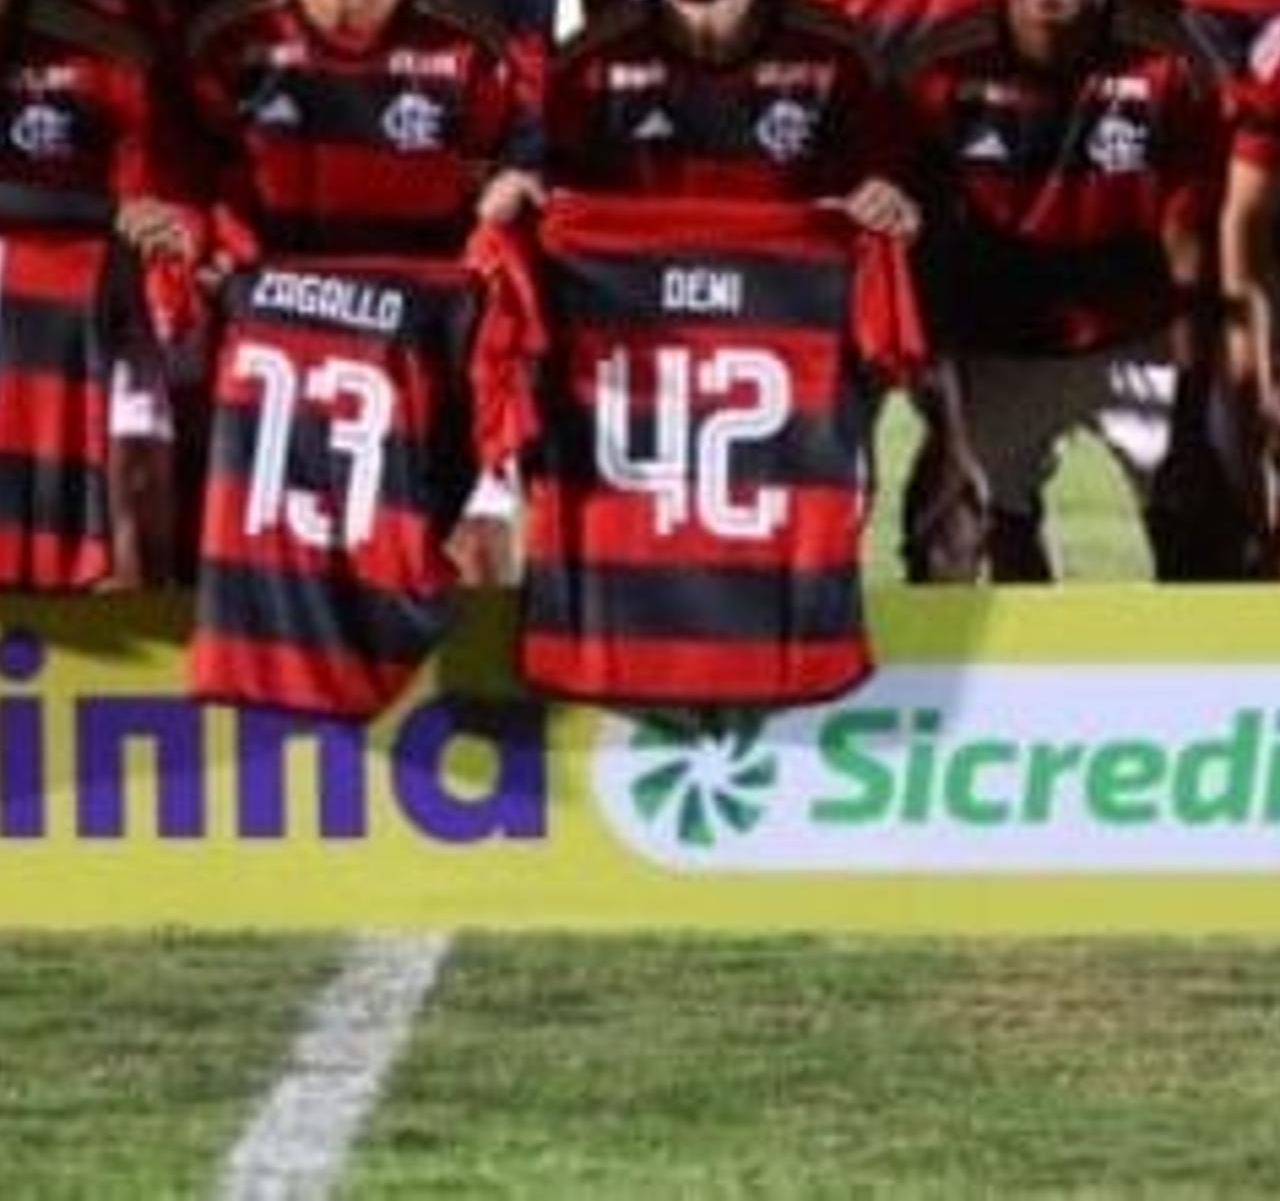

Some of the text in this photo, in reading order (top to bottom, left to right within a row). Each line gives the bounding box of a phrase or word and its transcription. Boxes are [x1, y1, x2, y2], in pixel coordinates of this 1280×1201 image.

[252, 270, 404, 332] ZAGALLO
[232, 341, 396, 556] 13
[596, 344, 793, 540] 42
